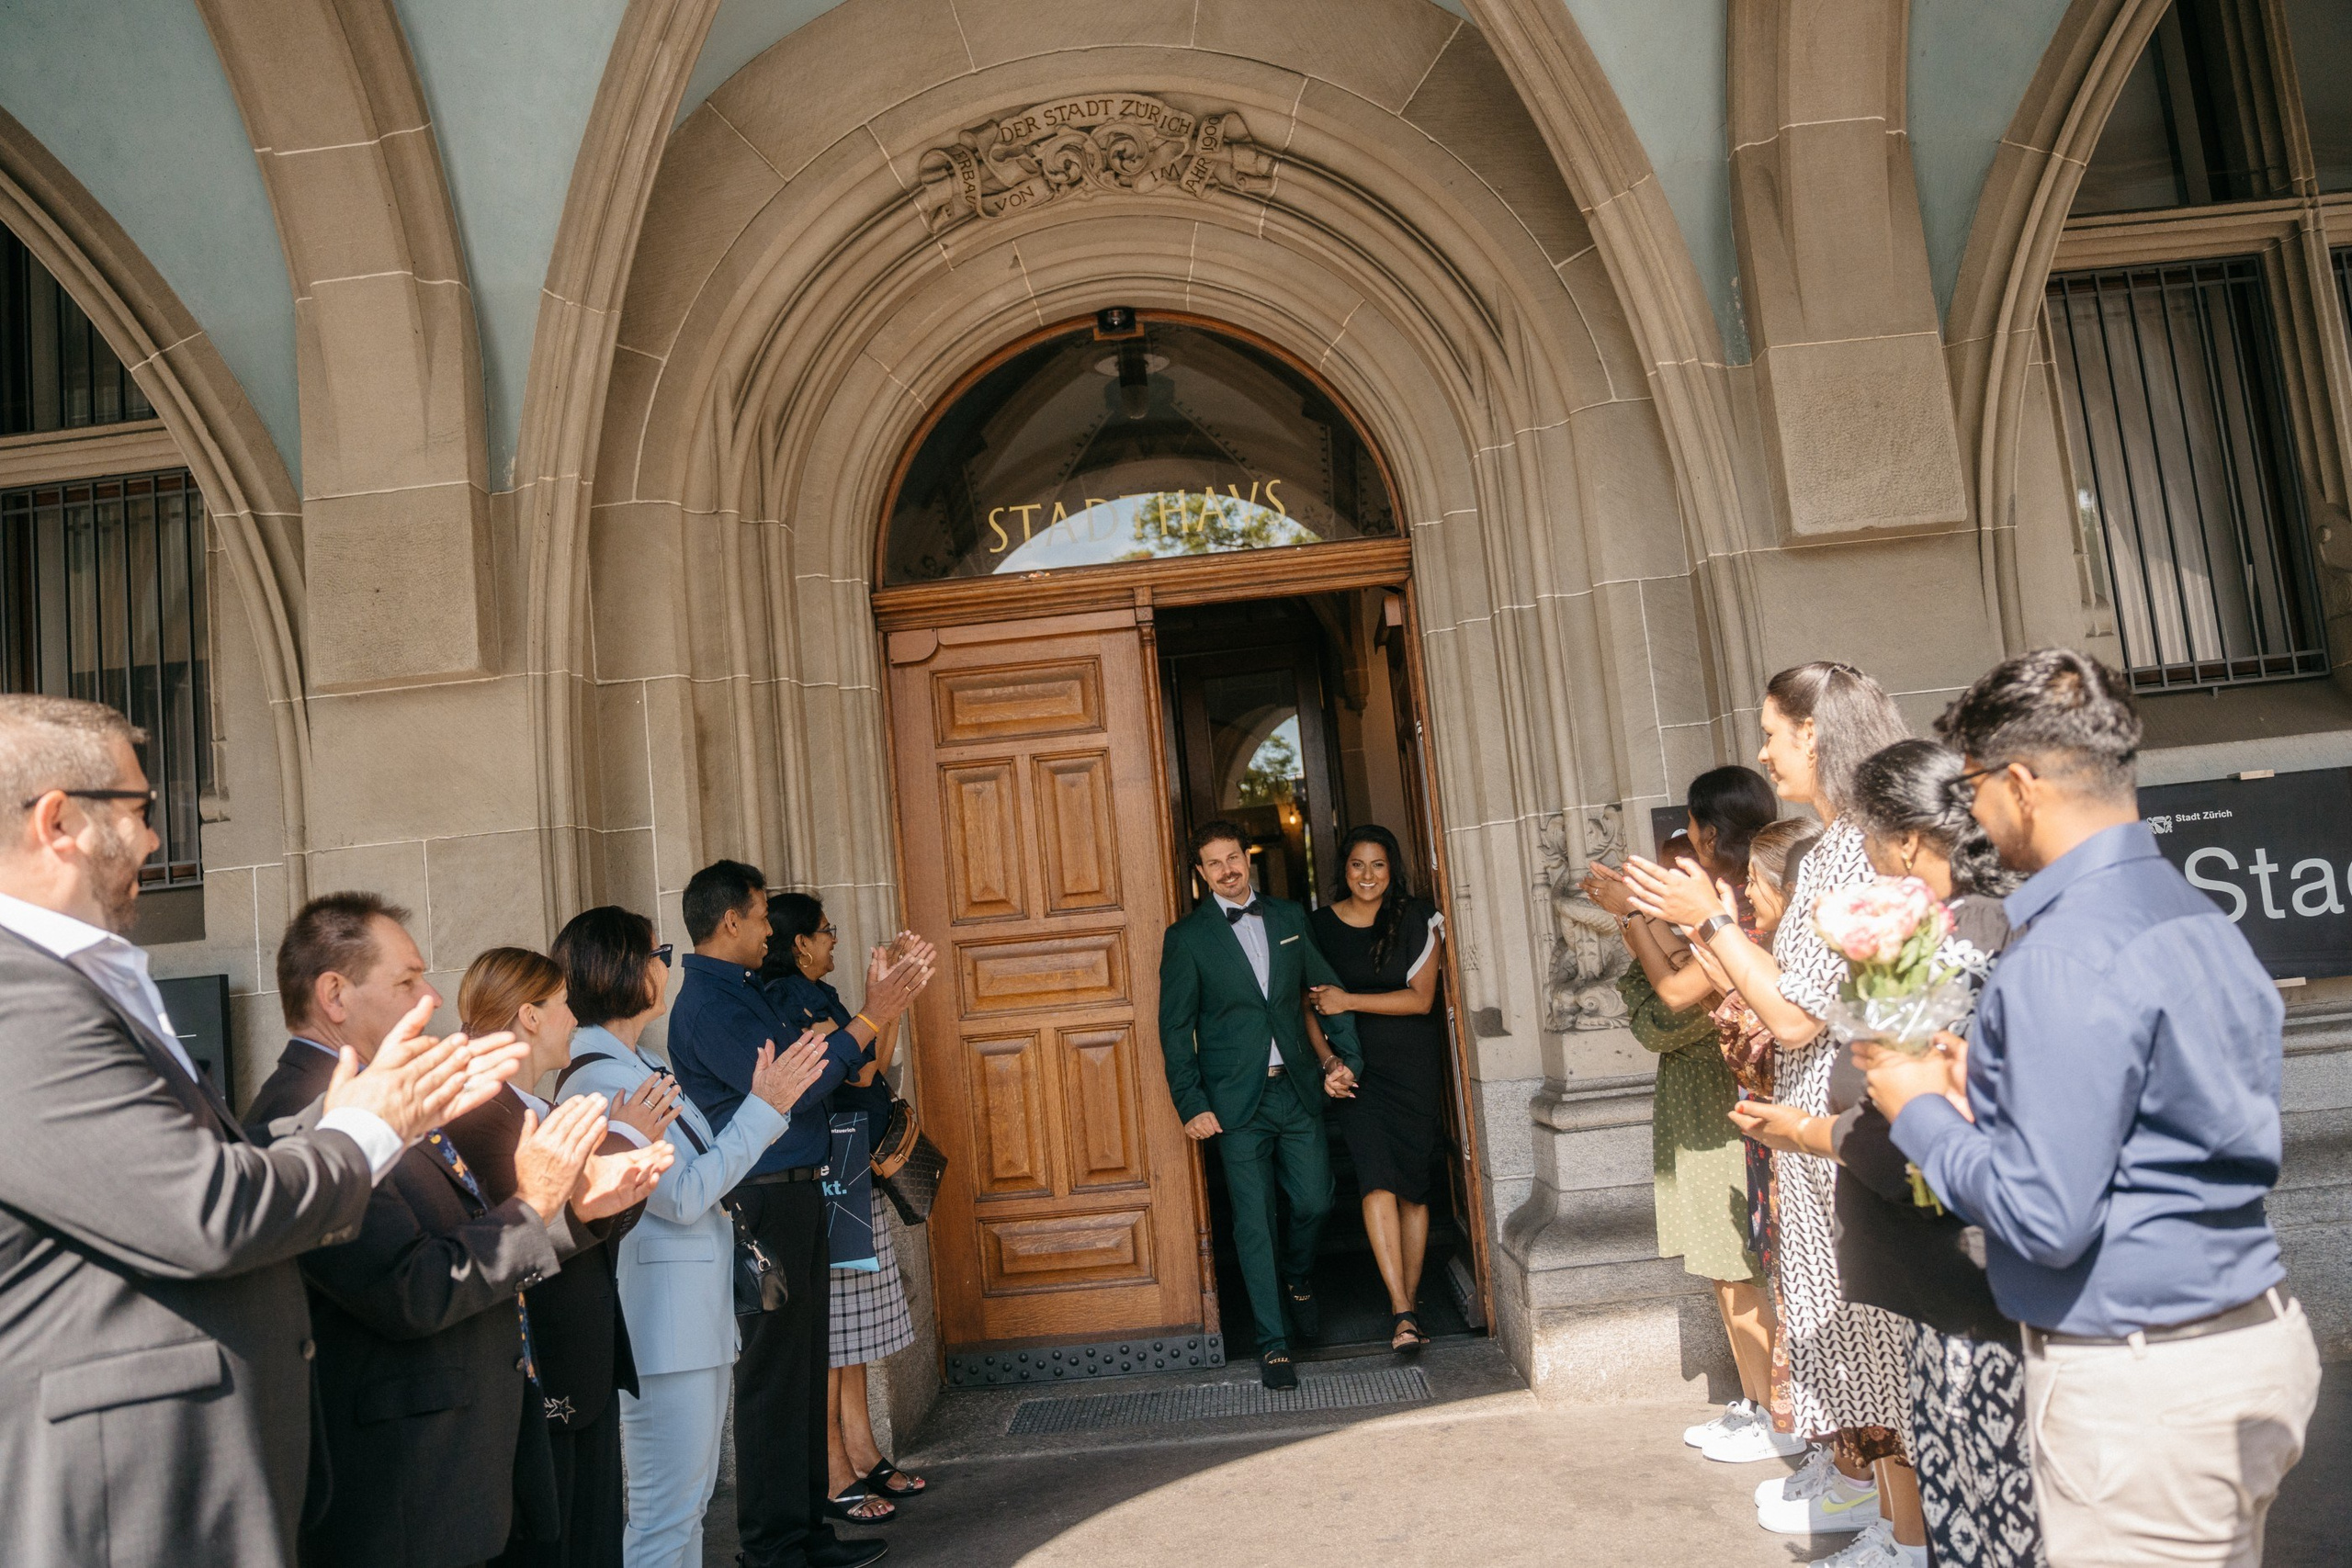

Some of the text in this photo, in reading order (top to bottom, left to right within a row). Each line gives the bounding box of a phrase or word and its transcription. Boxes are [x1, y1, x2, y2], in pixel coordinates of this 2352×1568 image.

[1000, 99, 1193, 143] DER STADT ZÜRICH
[1201, 117, 1220, 151] 1900
[952, 151, 976, 209] ERBAU
[1150, 163, 1181, 182] IM
[994, 186, 1035, 211] VON
[2175, 809, 2233, 822] Stadt Zürich
[2185, 846, 2352, 924] Sta
